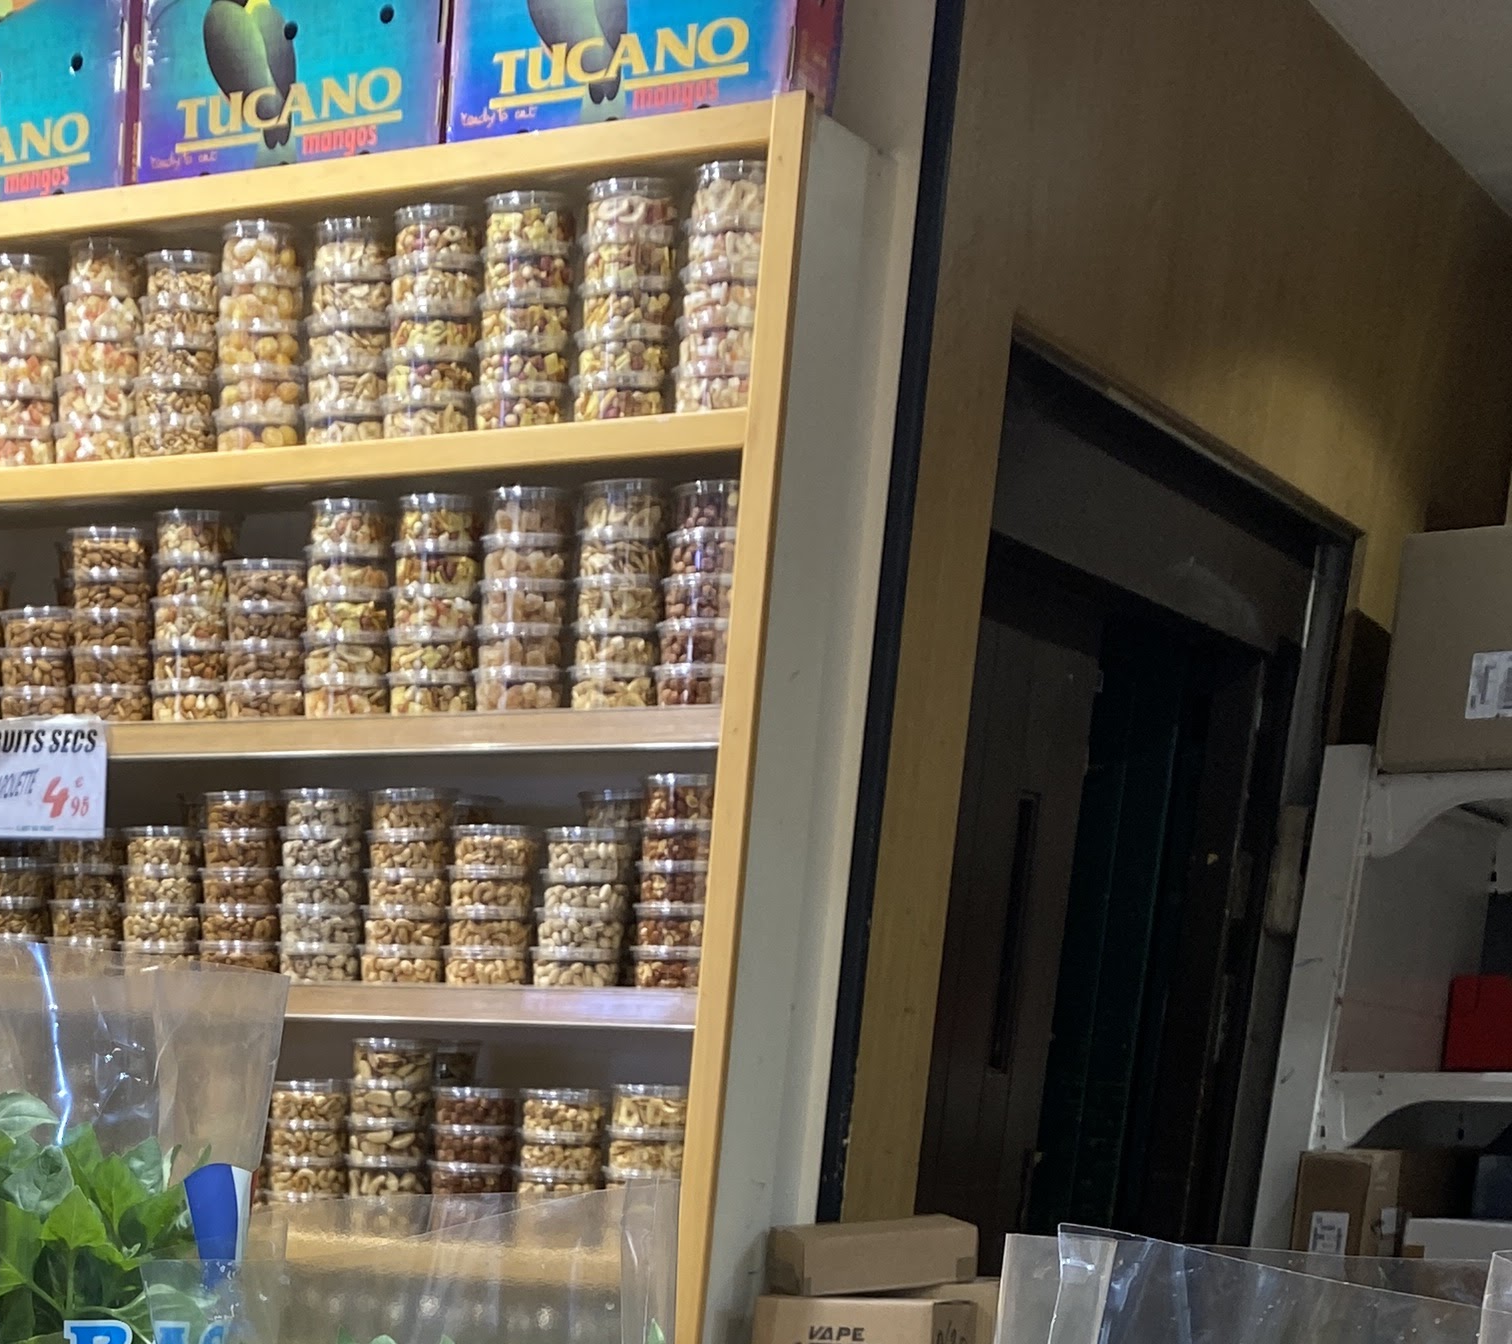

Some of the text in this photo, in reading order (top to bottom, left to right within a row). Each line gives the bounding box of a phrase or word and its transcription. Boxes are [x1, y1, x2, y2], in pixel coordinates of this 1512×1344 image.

[493, 17, 749, 94] TUCANO
[176, 67, 402, 140] TUCANO
[633, 79, 719, 111] mangos
[303, 123, 377, 156] mangos
[5, 168, 70, 195] mangos
[49, 729, 98, 753] SECS
[42, 776, 69, 818] 4
[808, 1326, 865, 1342] VAPE
